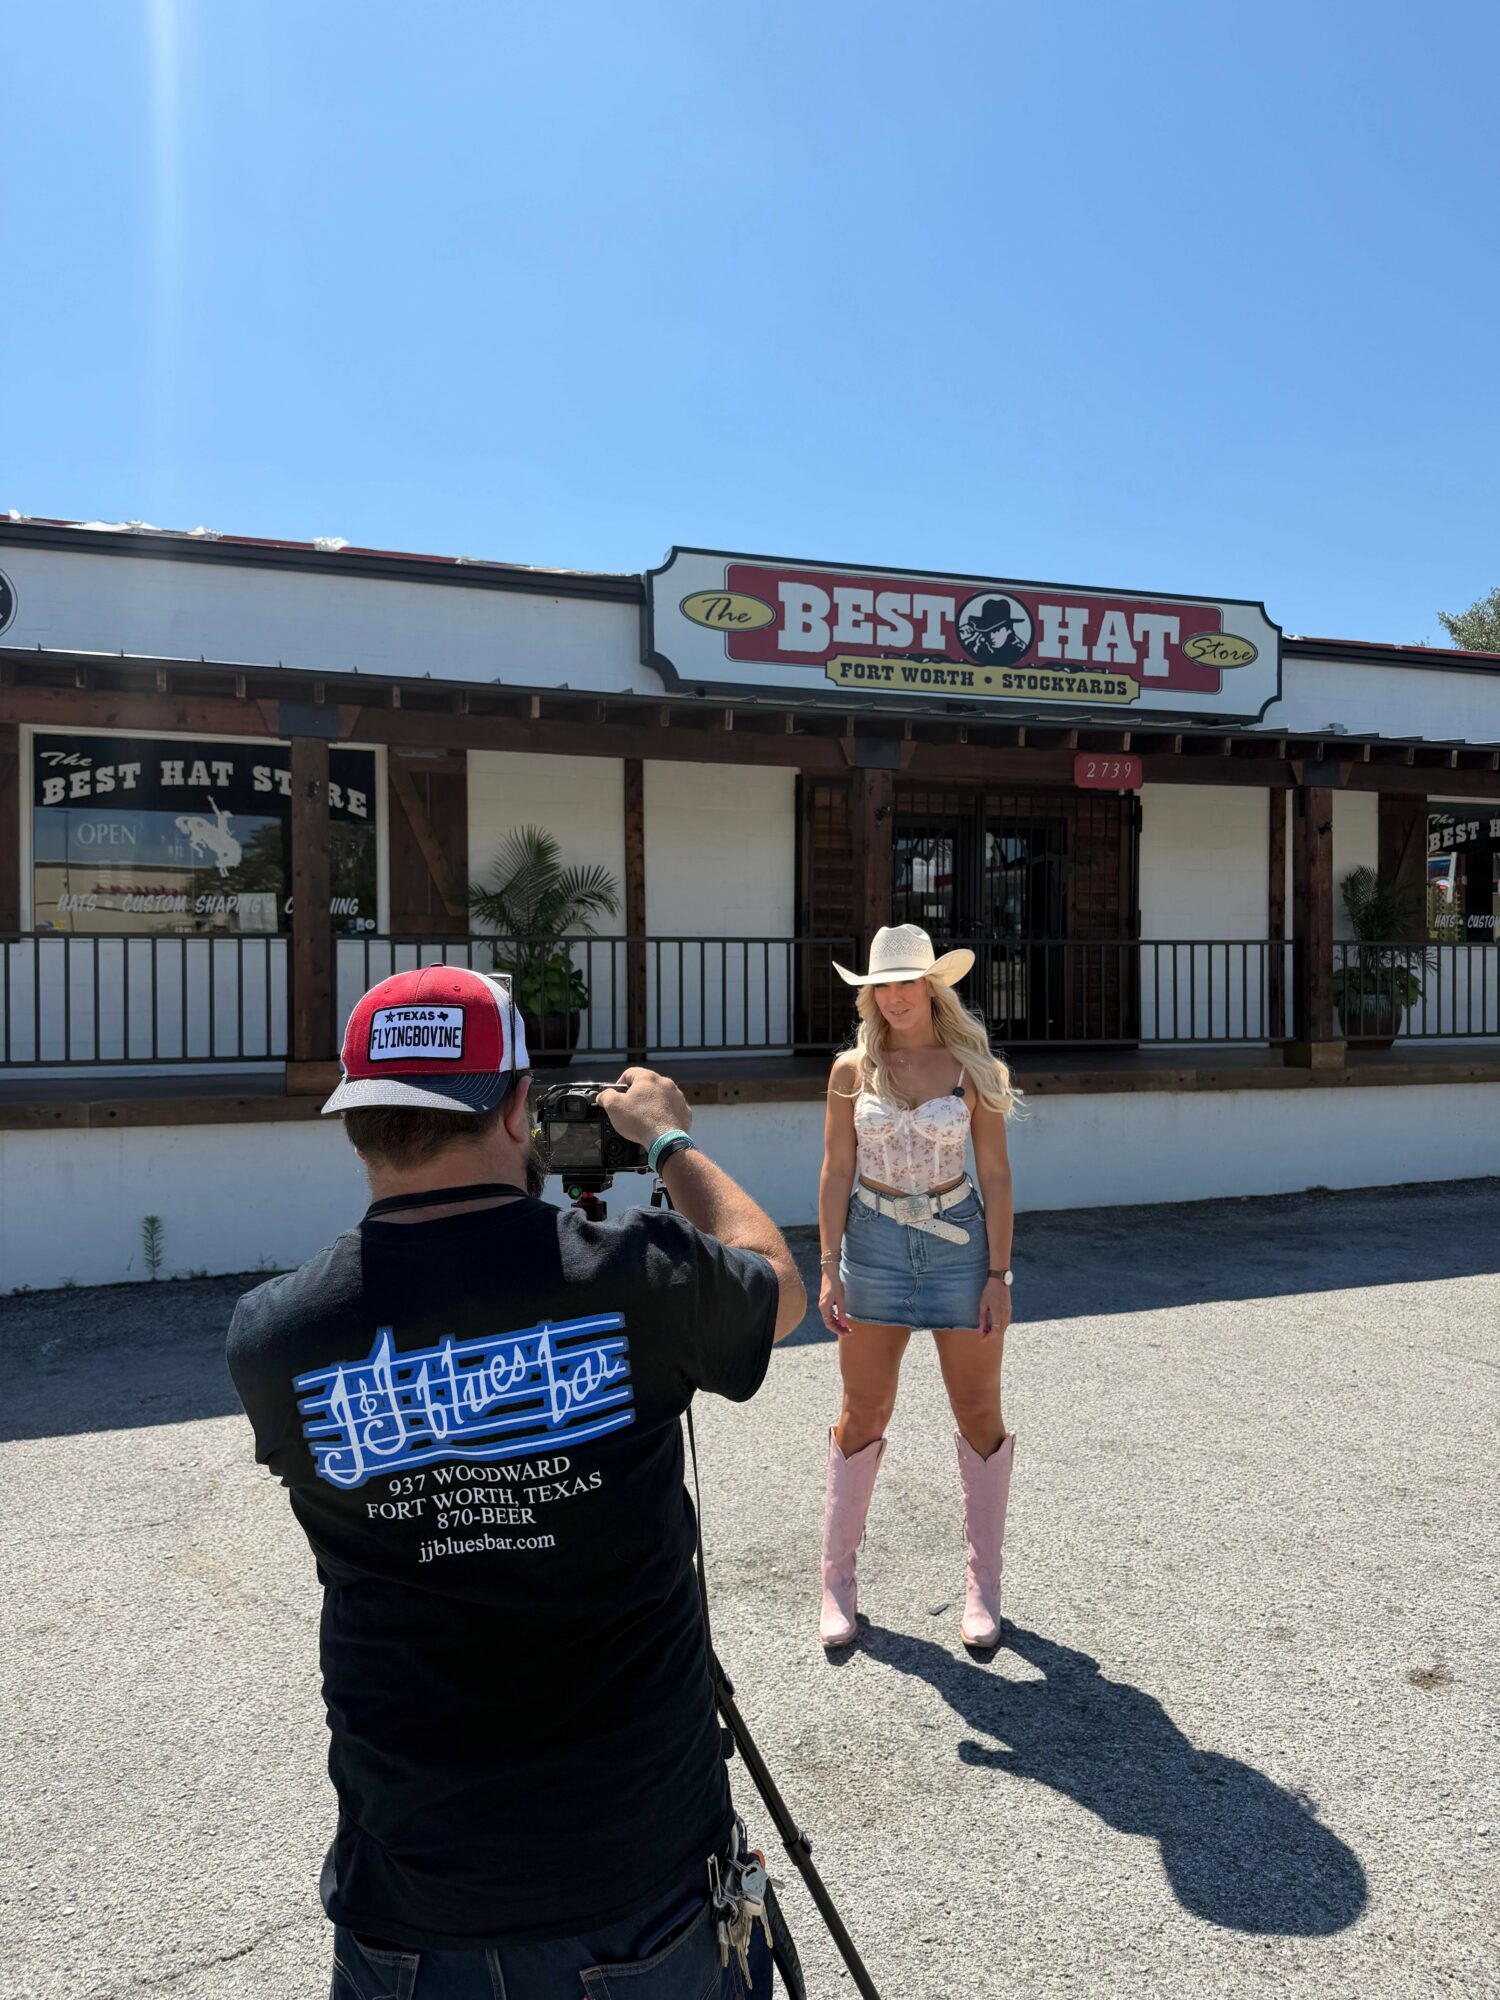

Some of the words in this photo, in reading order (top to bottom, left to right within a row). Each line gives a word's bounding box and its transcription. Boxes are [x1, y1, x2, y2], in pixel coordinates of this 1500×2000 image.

[702, 597, 752, 623] The
[778, 581, 956, 652] BEST
[1038, 604, 1180, 677] HAT
[1191, 637, 1254, 661] Store
[840, 662, 894, 681] FORT
[902, 667, 974, 687] WORTH
[1002, 673, 1127, 695] STOCKYARDS
[40, 752, 93, 768] The
[1087, 762, 1133, 779] 2739
[43, 763, 141, 805] BEST
[160, 760, 234, 786] HAT
[253, 765, 367, 818] STRE
[1428, 814, 1455, 825] The
[77, 823, 137, 845] OPEN
[1429, 821, 1480, 851] BEST
[57, 894, 97, 912] HATS
[122, 894, 187, 913] CUSTOM
[1434, 915, 1456, 928] HATS
[397, 1011, 435, 1021] TEXAS
[371, 1026, 461, 1050] FLYINGBOVINE
[389, 1475, 426, 1496] 937
[432, 1456, 570, 1485] WOODWARD
[366, 1499, 427, 1520] FORT
[431, 1487, 520, 1510] WORTH,
[523, 1471, 603, 1504] TEXAS
[437, 1507, 536, 1529] 870-BEER
[418, 1533, 556, 1562] jjbluesbar.com
